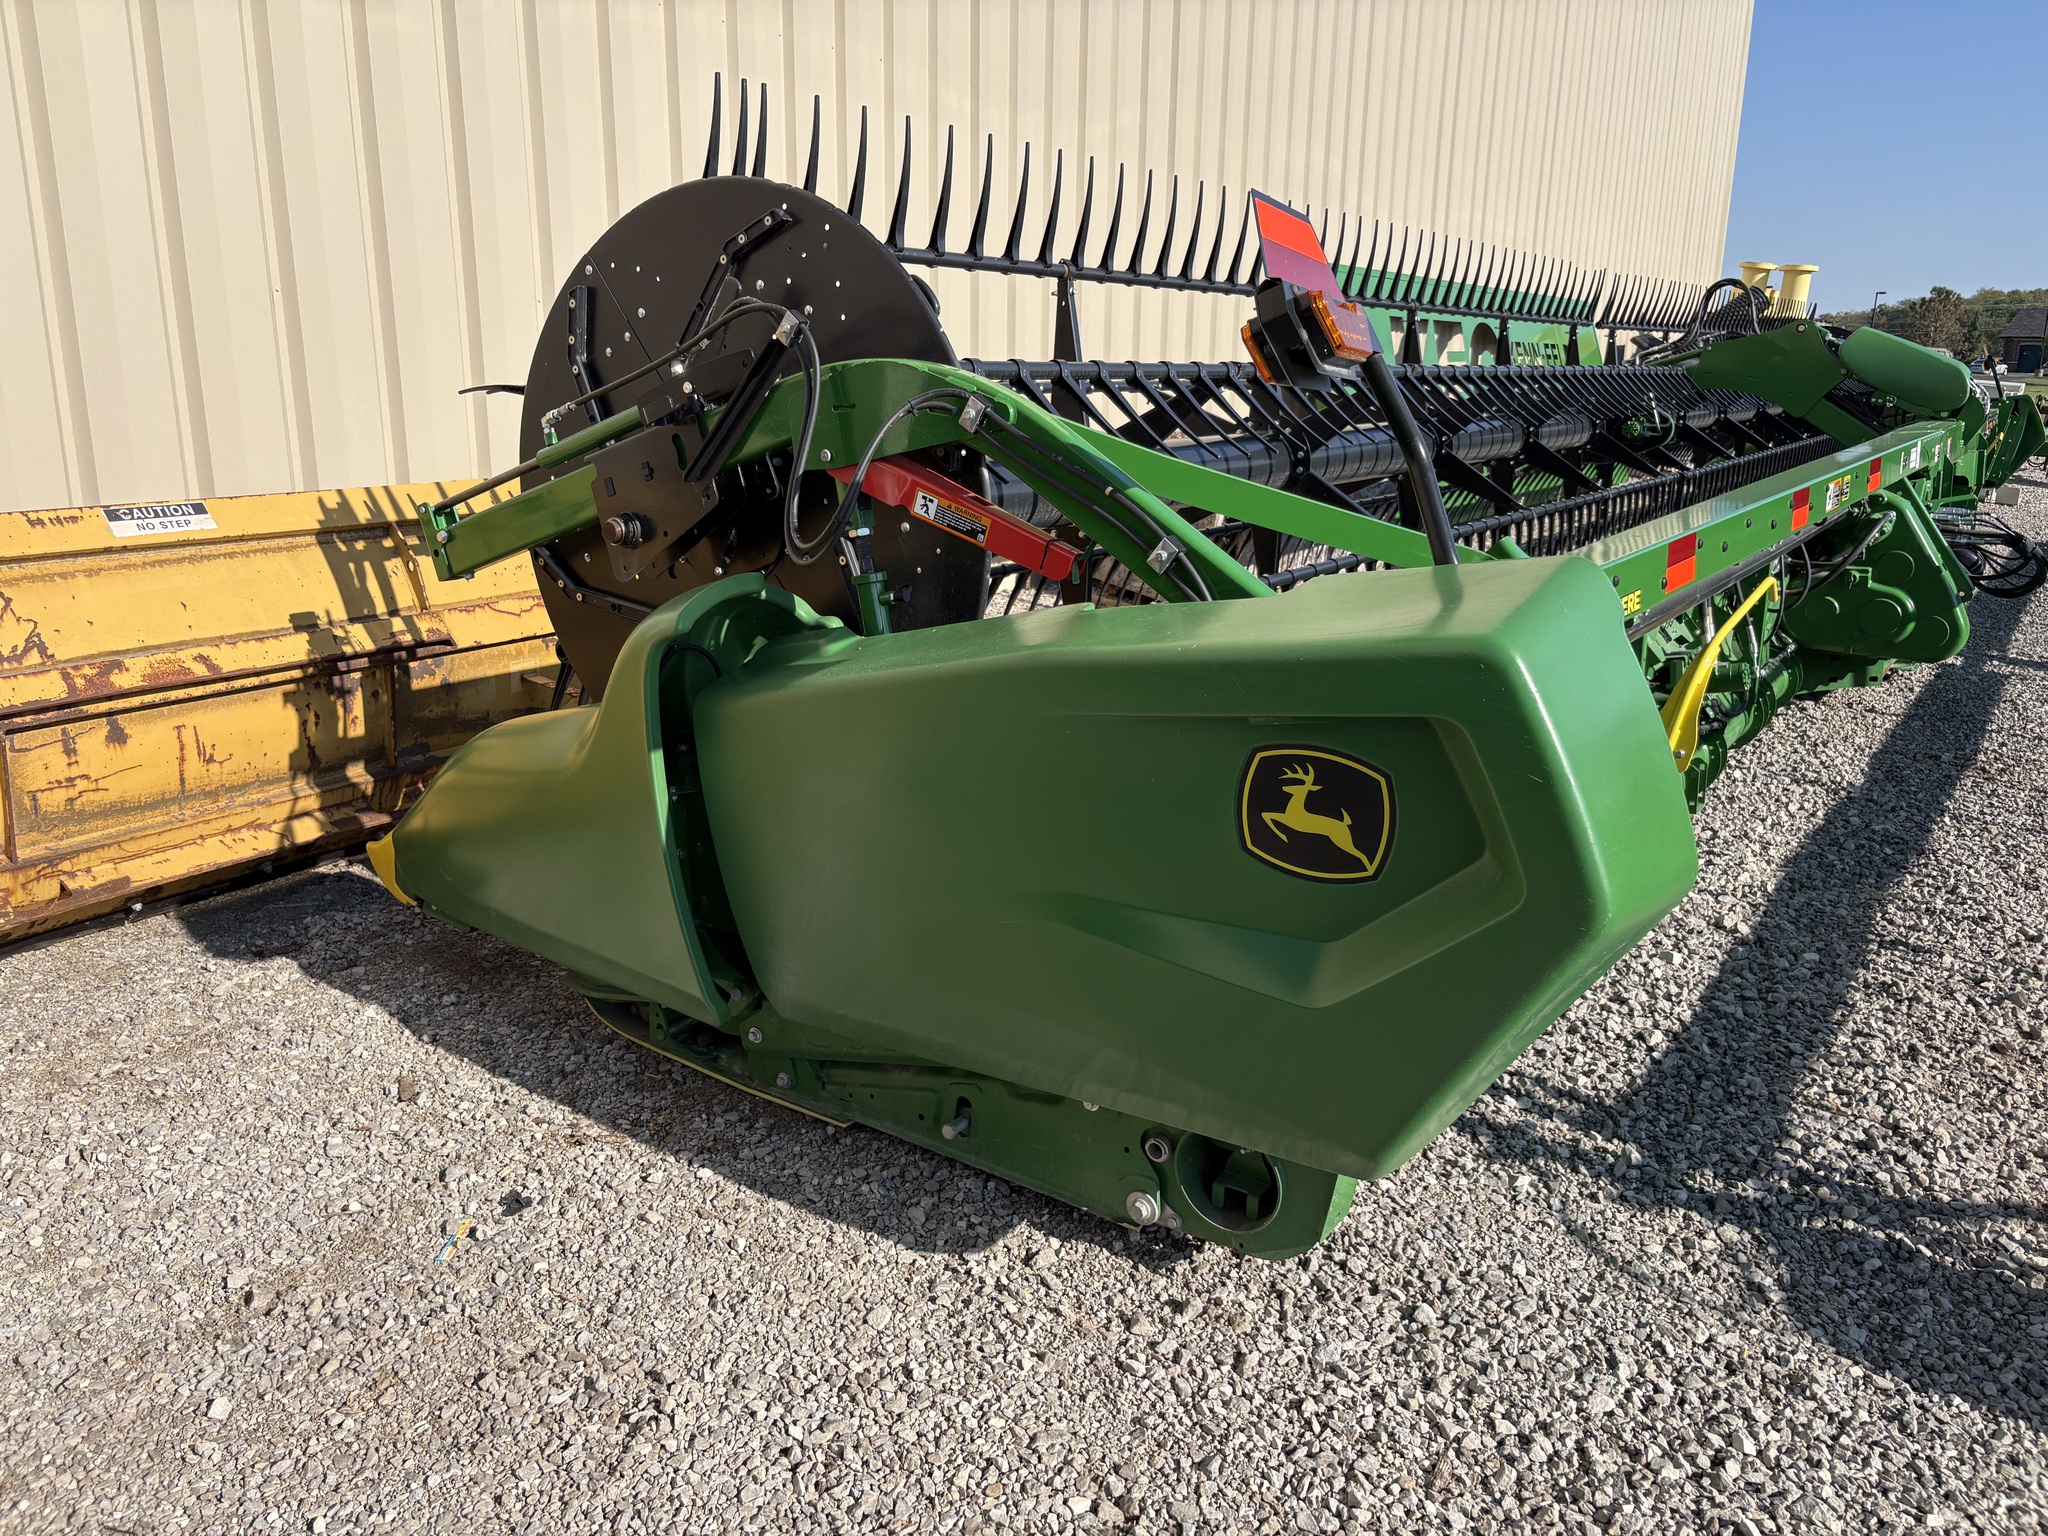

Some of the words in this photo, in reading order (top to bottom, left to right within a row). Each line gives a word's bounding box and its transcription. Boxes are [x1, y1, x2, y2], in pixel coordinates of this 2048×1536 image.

[119, 504, 195, 520] CAUTION
[954, 505, 983, 523] WARNING
[136, 522, 156, 532] NO
[160, 519, 192, 530] STEP
